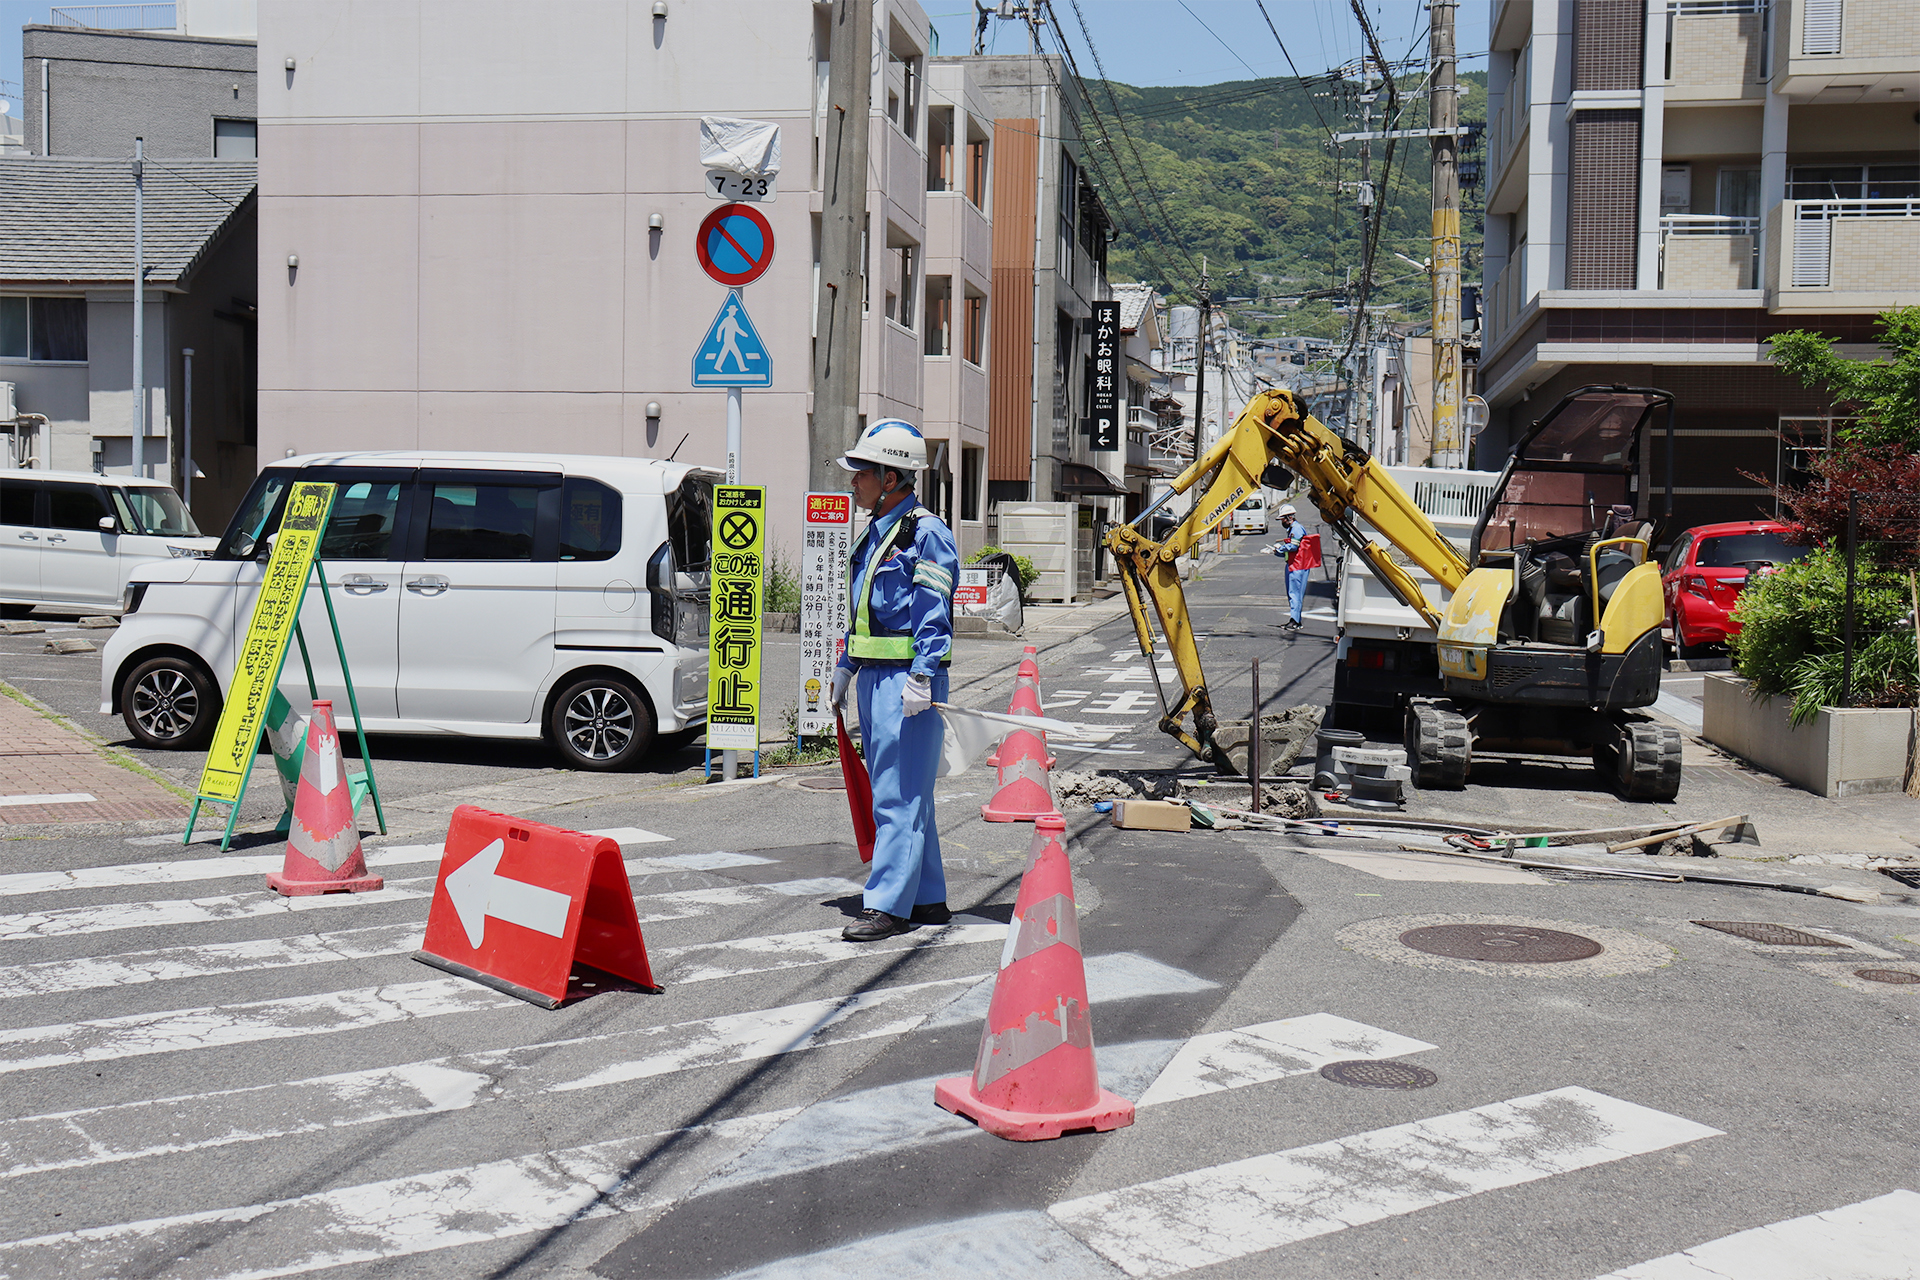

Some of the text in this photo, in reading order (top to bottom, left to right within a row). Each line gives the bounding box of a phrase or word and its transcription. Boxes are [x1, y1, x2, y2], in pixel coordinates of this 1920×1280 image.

[715, 176, 769, 196] 7-23
[1096, 308, 1113, 391] ほかお眼科
[1098, 418, 1111, 434] P
[718, 490, 746, 499] ご迷惑を
[718, 498, 759, 507] おかけします
[291, 494, 325, 518] お願い
[810, 497, 847, 511] 通行止
[1201, 486, 1245, 525] YANMAR
[811, 511, 844, 521] のご案内
[806, 530, 816, 548] 時間
[816, 530, 826, 548] 期間
[714, 552, 760, 577] この先
[711, 578, 757, 714] 通行止
[711, 724, 755, 734] MIZUNO
